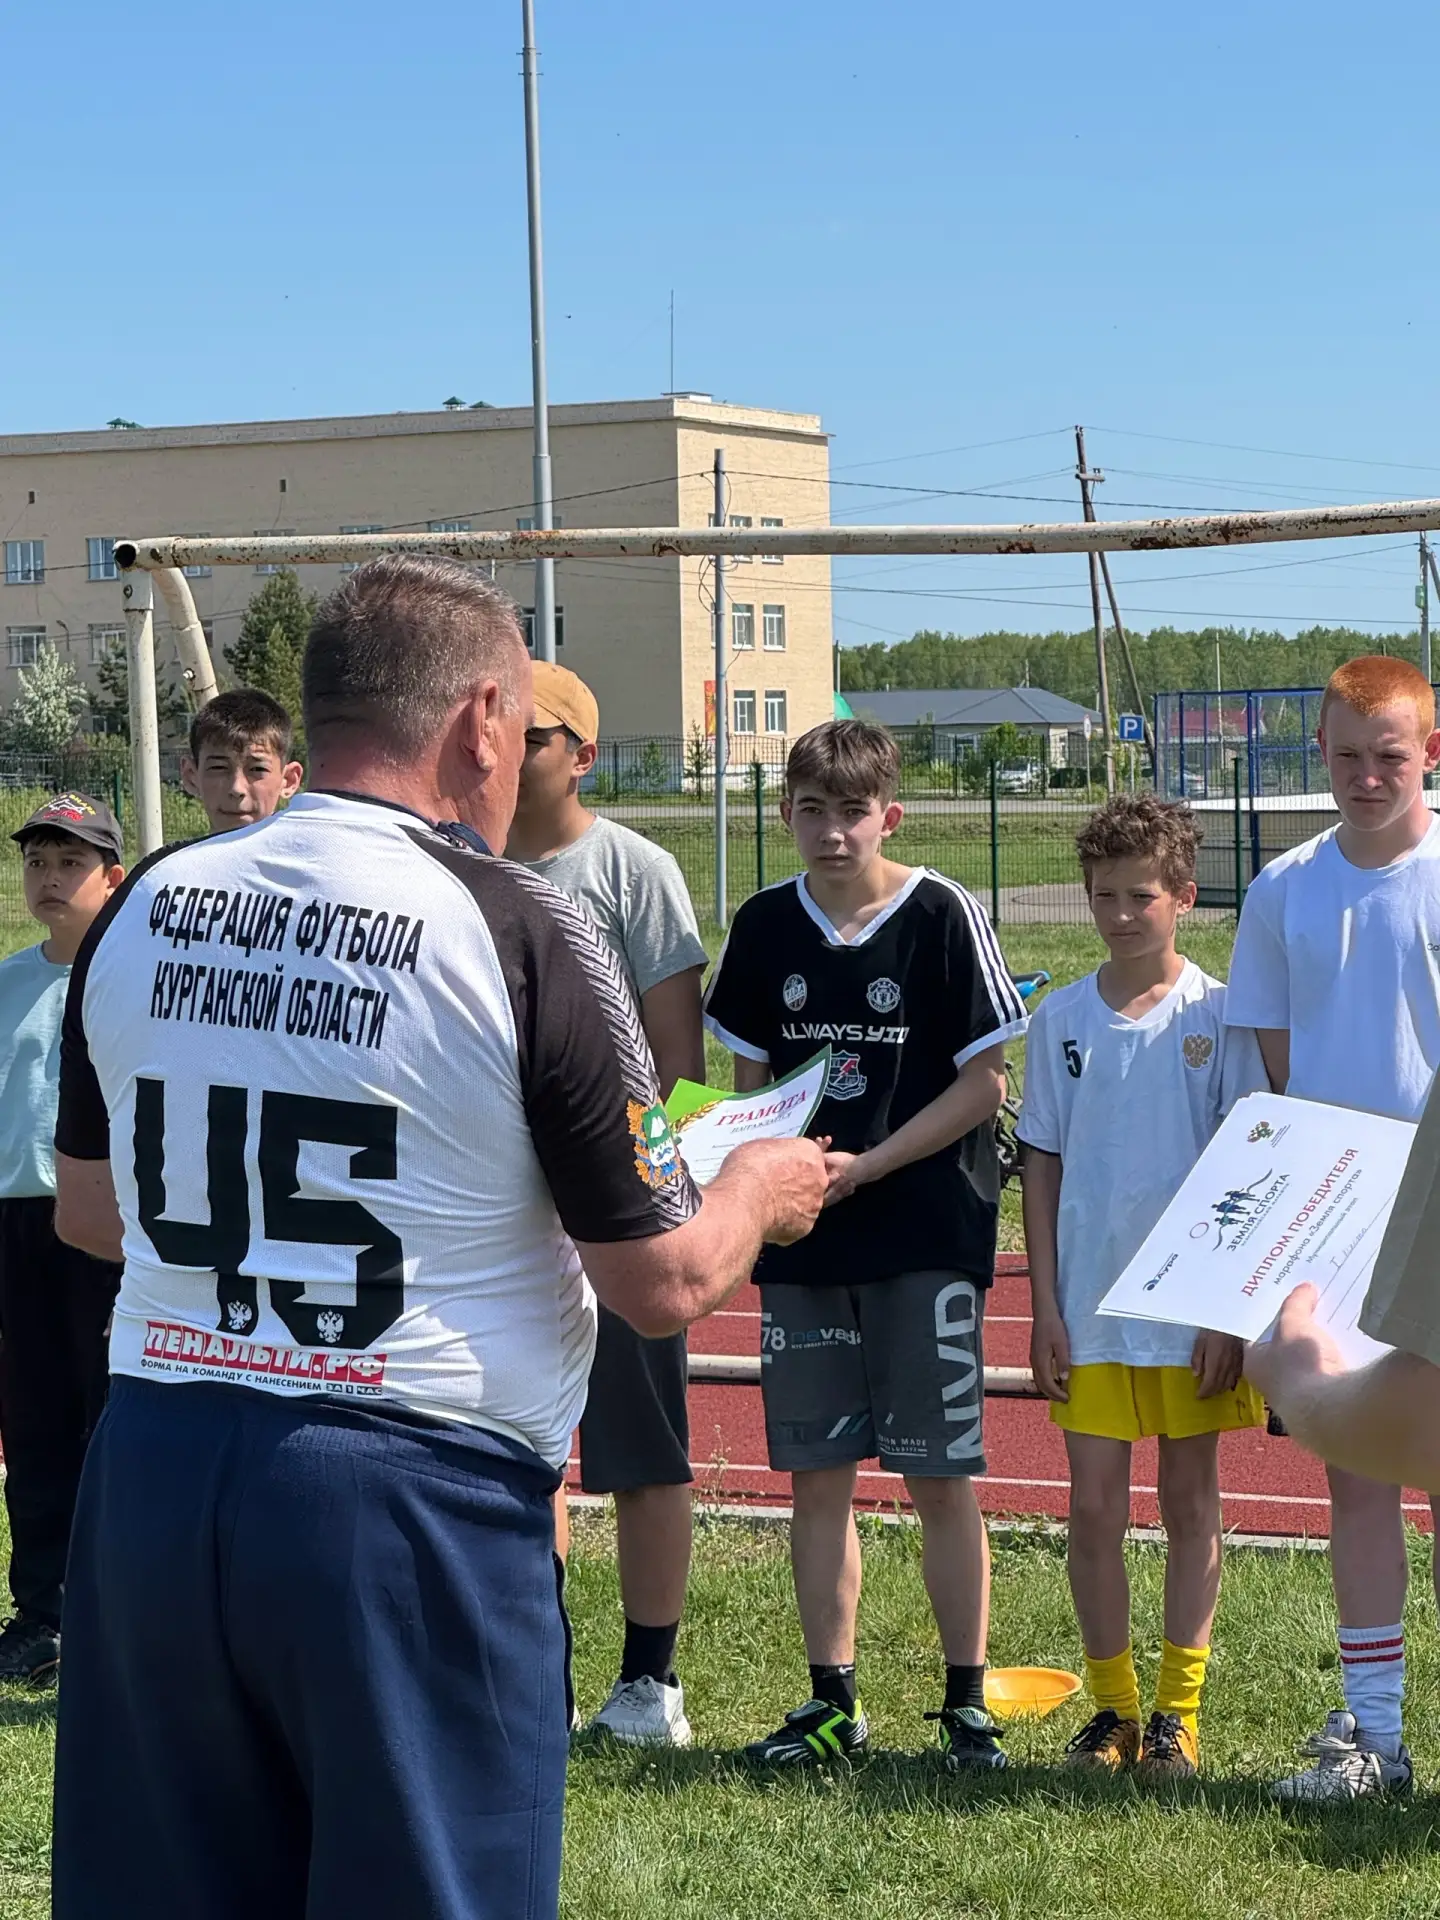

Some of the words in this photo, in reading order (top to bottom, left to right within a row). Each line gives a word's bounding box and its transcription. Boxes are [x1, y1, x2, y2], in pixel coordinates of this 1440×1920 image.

[1124, 718, 1138, 738] P
[149, 883, 292, 956] ФЕДЕРАЦИЯ
[296, 898, 424, 974] ФУТБОЛА
[150, 960, 285, 1033] КУРГАНСКОЙ
[285, 976, 390, 1051] ОБЛАСТИ
[781, 1022, 863, 1041] ALWAYS
[1062, 1040, 1082, 1079] 5
[714, 1090, 806, 1127] ГРАМОТА
[132, 1076, 405, 1350] 45
[1227, 1216, 1257, 1251] ЗЕМЛЯ
[1254, 1173, 1290, 1215] СПОРТА
[1241, 1235, 1294, 1297] ДИПЛОМ
[1287, 1148, 1359, 1232] ПОБЕДИТЕЛЯ
[1274, 1238, 1310, 1285] марафона
[1309, 1205, 1335, 1238] «Земля
[1333, 1168, 1362, 1204] спорта»
[145, 1325, 384, 1377] ПЕНАЛЬТИ.РФ
[761, 1327, 786, 1351] 78
[140, 1358, 172, 1372] ФОРМА
[175, 1364, 189, 1375] НА
[192, 1368, 243, 1382] КОМАНДУ
[245, 1373, 252, 1382] С
[254, 1376, 322, 1391] НАНЕСЕНИЕМ
[357, 1387, 382, 1396] ЧАС
